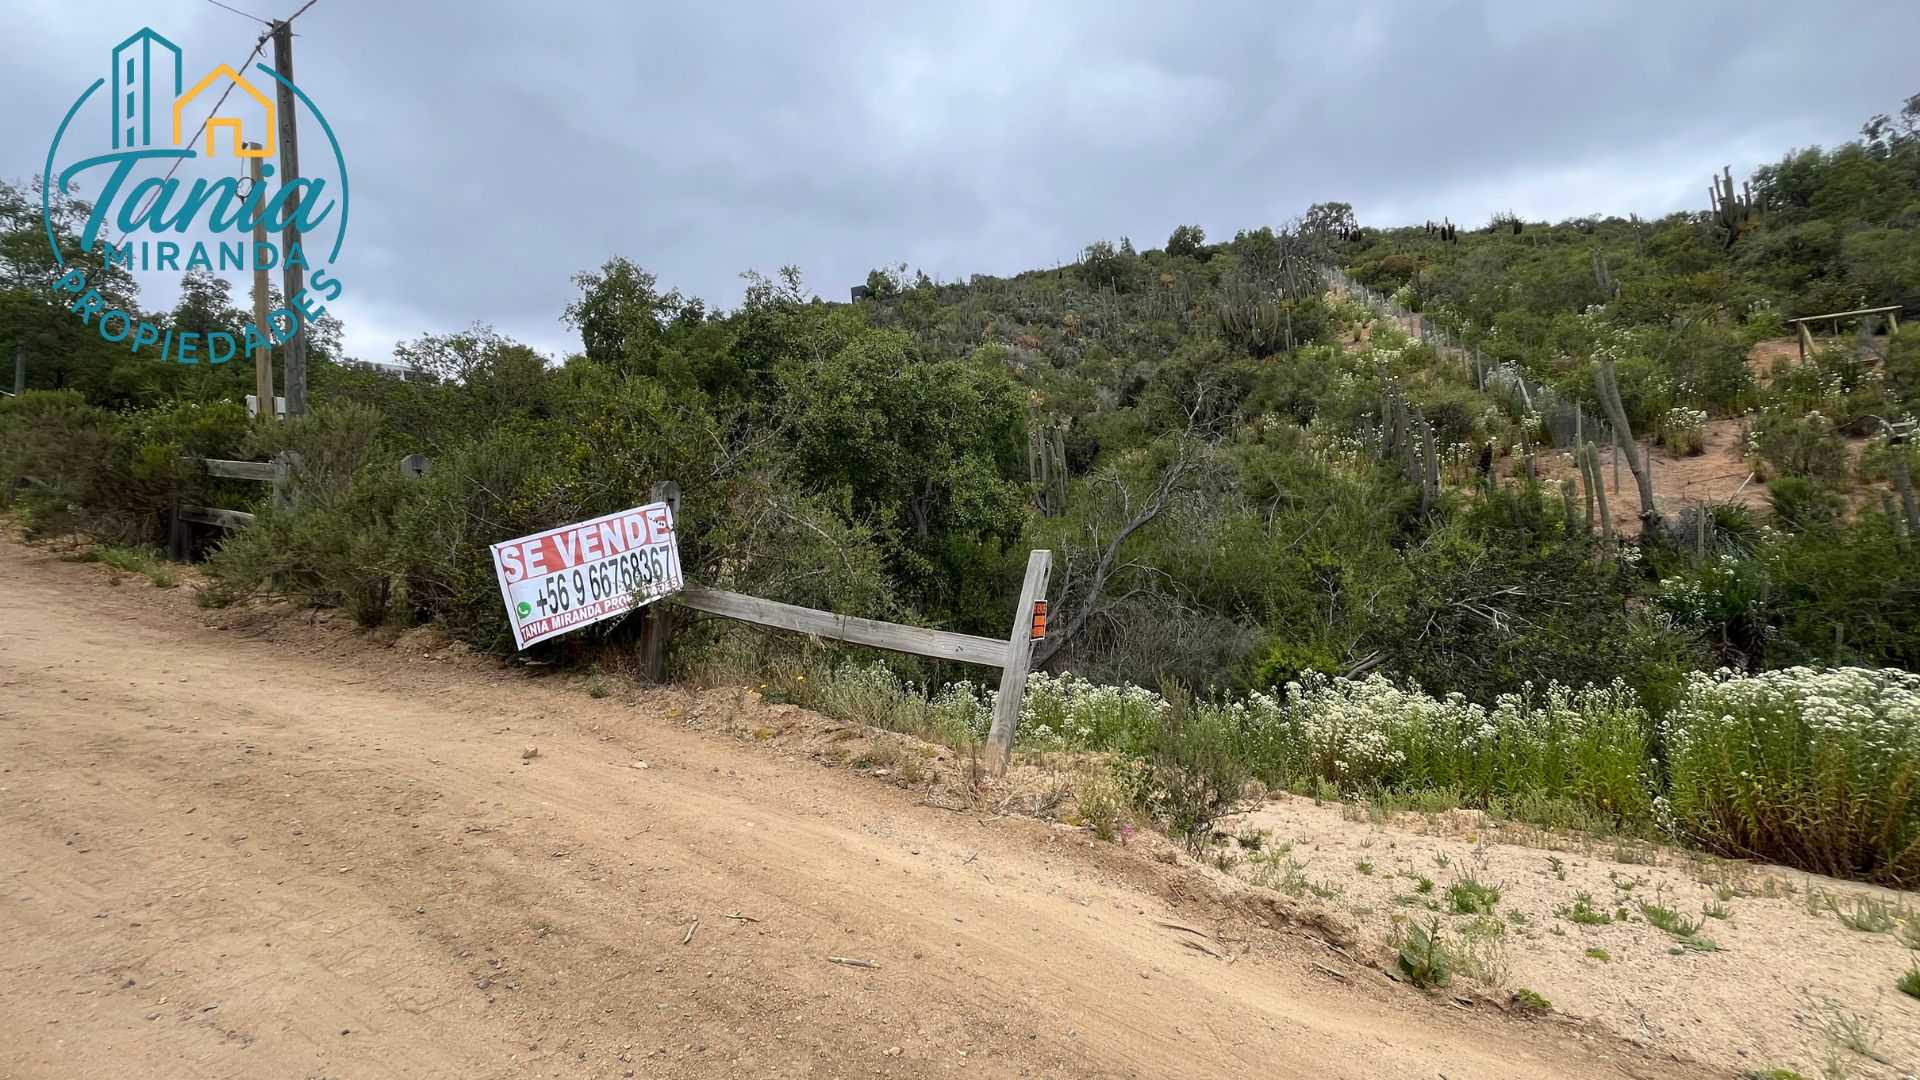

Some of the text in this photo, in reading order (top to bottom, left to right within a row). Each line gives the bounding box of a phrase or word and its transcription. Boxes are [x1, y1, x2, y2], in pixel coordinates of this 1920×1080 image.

[500, 509, 671, 582] SE VENDE
[536, 545, 671, 616] +56 9 66768367
[521, 621, 549, 641] TANIA
[551, 603, 602, 629] MIRANDA
